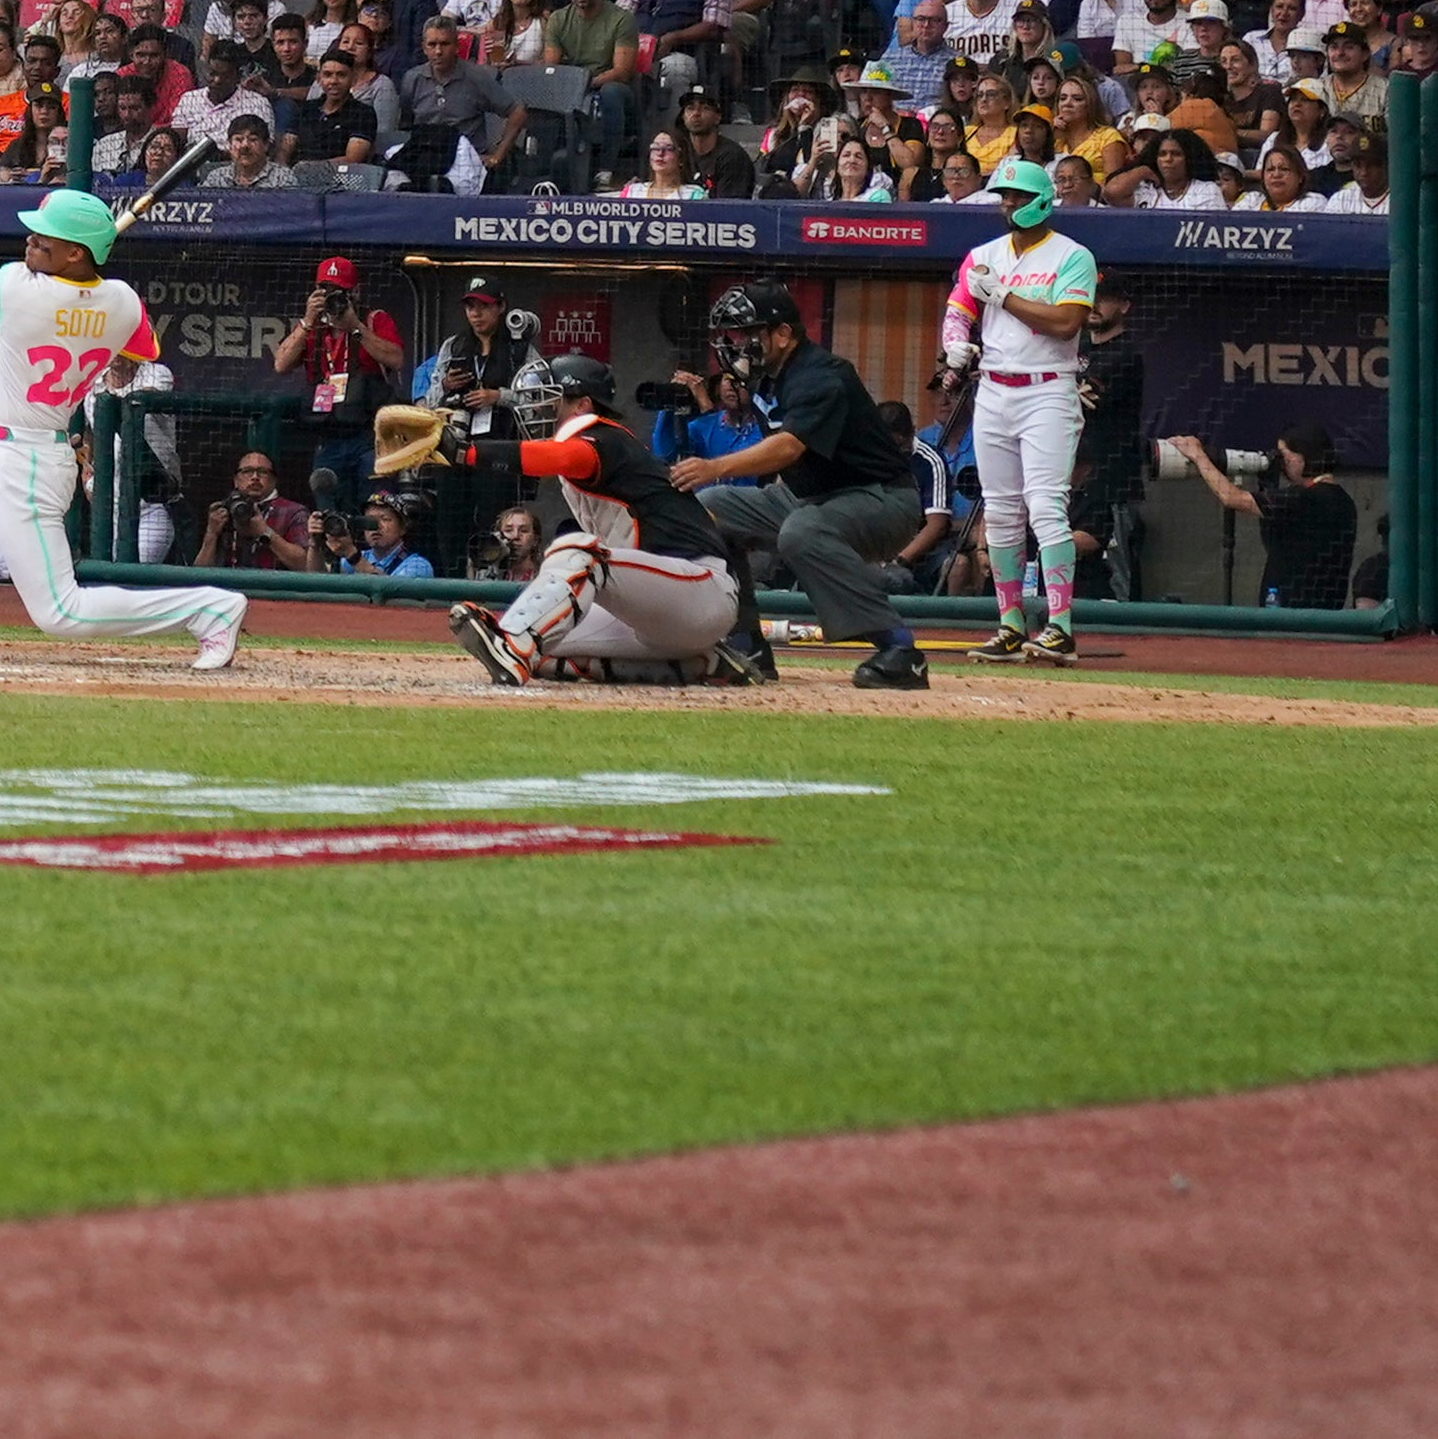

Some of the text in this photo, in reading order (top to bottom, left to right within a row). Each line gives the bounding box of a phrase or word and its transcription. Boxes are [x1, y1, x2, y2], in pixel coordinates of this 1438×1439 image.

[552, 203, 681, 218] MLB WORLD TOUR
[455, 218, 756, 248] MEXICO CITY SERIES
[833, 225, 923, 240] BANORTE
[174, 283, 241, 307] TOUR
[55, 308, 107, 339] SOTO
[26, 345, 111, 408] 22
